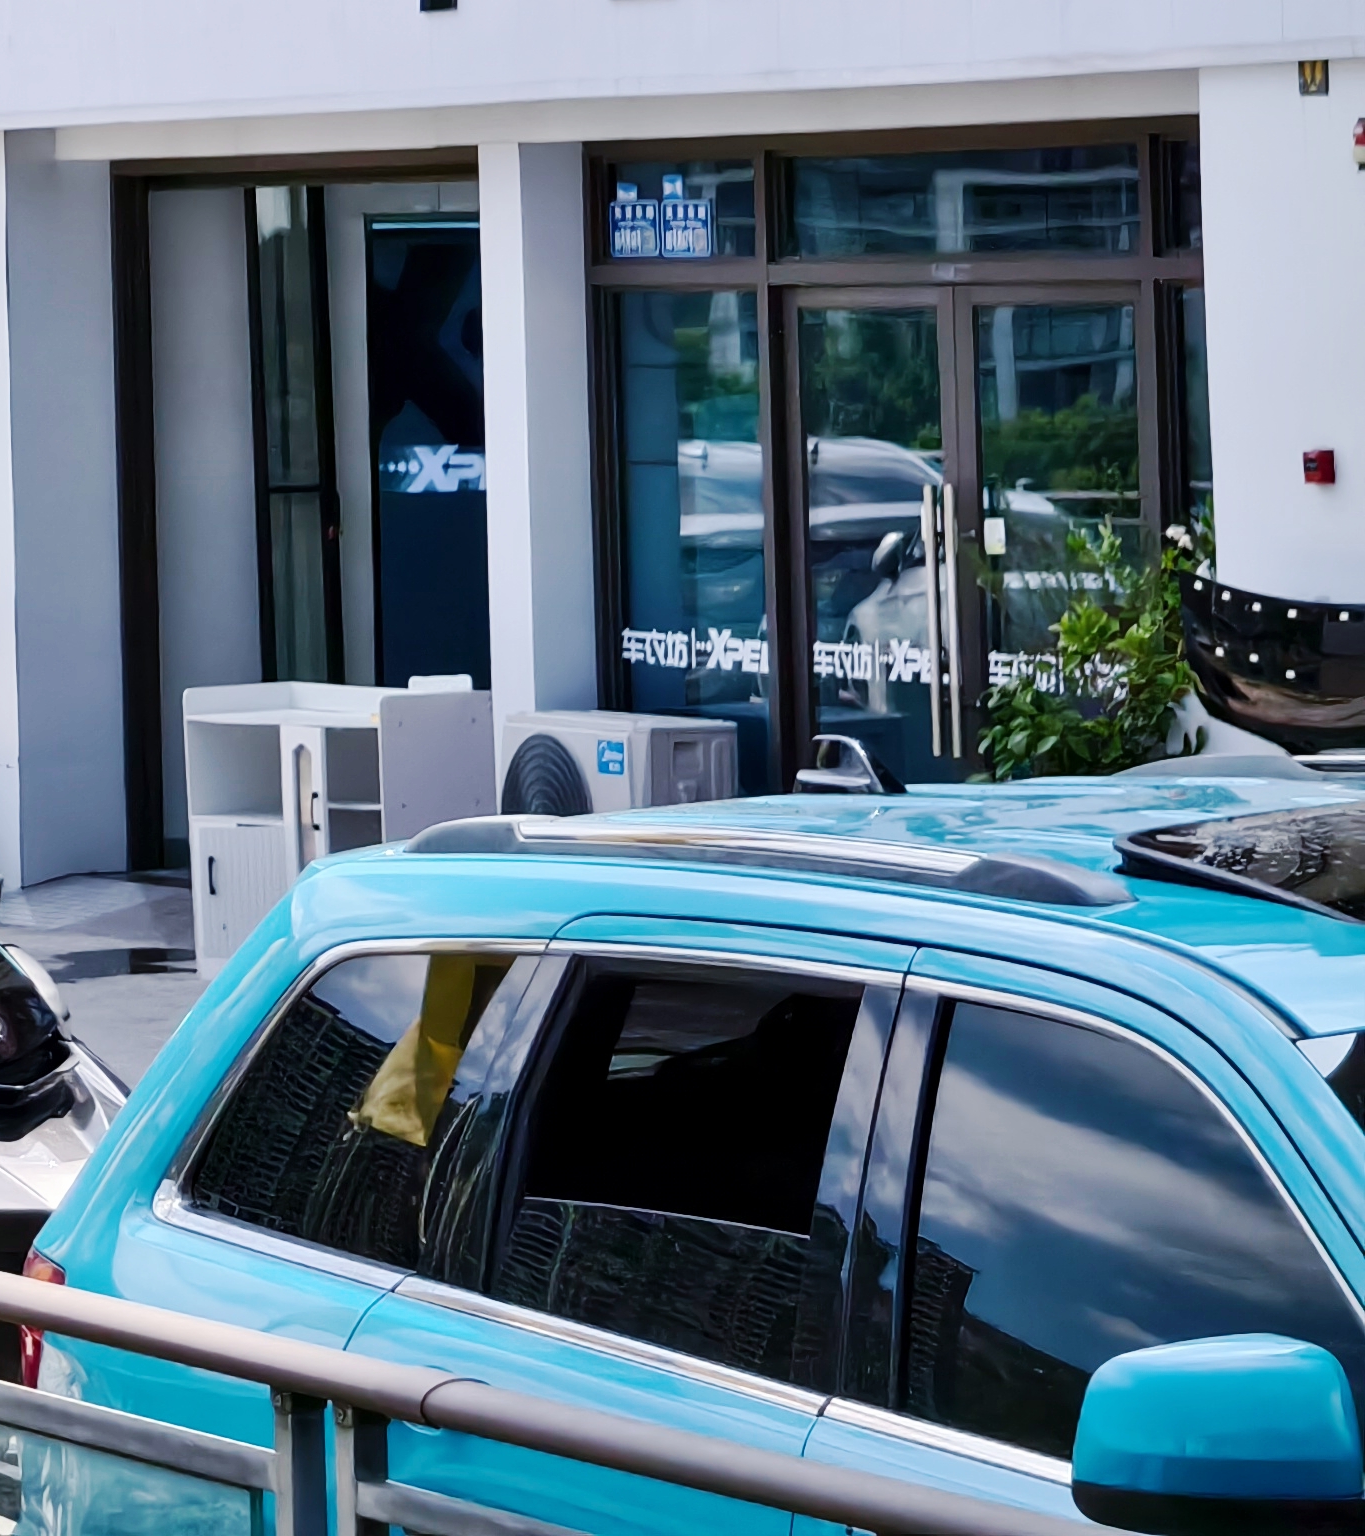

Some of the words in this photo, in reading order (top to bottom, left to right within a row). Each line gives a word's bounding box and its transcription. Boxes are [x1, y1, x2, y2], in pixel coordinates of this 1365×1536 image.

[407, 444, 485, 493] XP
[622, 627, 689, 669] 车衣坊
[813, 640, 873, 680] 车衣坊
[888, 638, 933, 685] XPE
